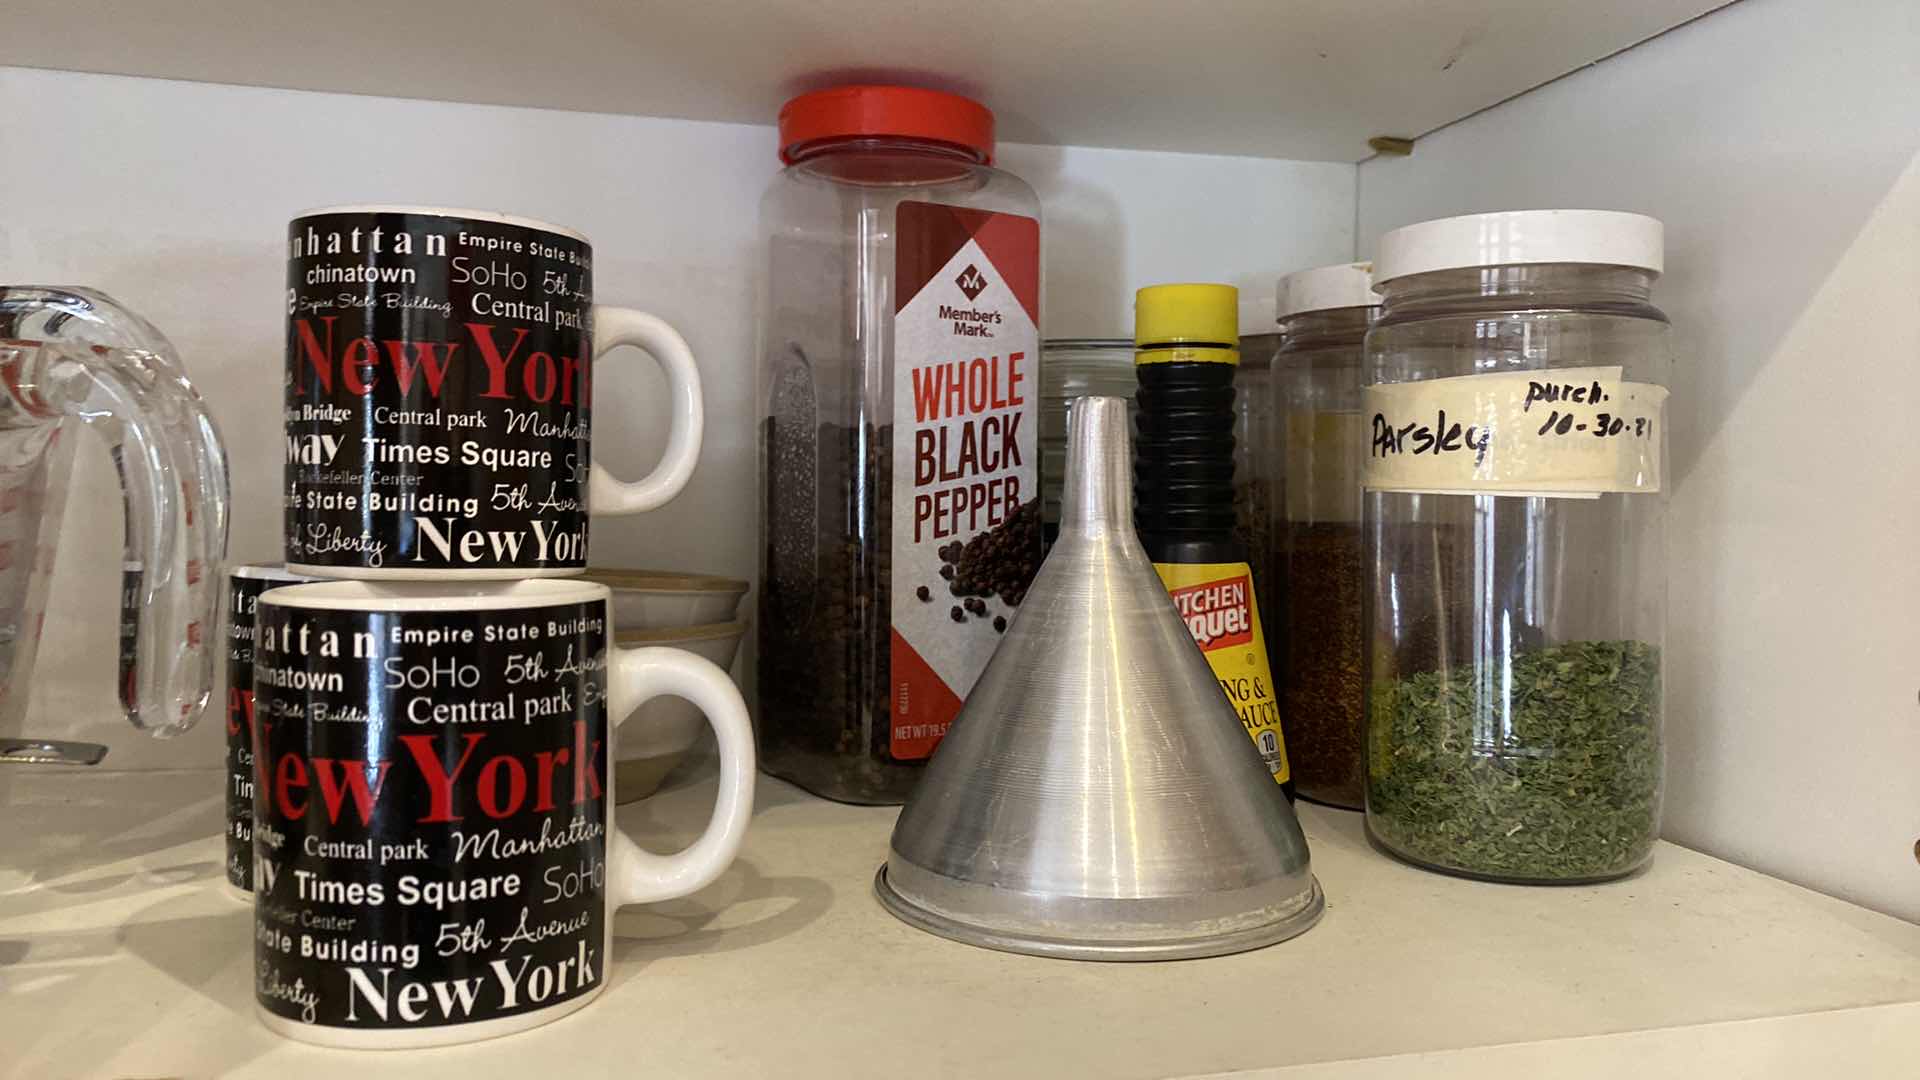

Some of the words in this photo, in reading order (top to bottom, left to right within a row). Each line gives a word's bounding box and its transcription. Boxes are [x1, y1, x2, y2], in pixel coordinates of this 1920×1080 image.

[459, 232, 523, 252] Empire
[530, 241, 566, 261] State
[306, 264, 416, 285] chinatown
[452, 257, 527, 290] SoHo
[381, 292, 455, 319] Building
[472, 292, 549, 323] Central
[555, 308, 583, 330] park
[939, 305, 1002, 325] Member's
[295, 316, 460, 399] New
[912, 352, 1025, 423] WHOLE
[1524, 381, 1609, 412] purch.
[303, 404, 352, 425] Bridge
[374, 407, 441, 427] Central
[447, 410, 488, 431] park
[362, 437, 450, 465] Times
[461, 440, 552, 472] Square
[915, 412, 1022, 487] BLACK
[371, 470, 424, 487] Center
[307, 491, 358, 510] State
[369, 493, 479, 518] Building
[491, 483, 533, 511] 5th
[914, 476, 1020, 544] PEPPER
[305, 522, 388, 568] Liberty
[412, 517, 527, 563] New
[392, 624, 474, 645] Empire
[485, 623, 540, 642] State
[548, 618, 602, 637] Building
[384, 656, 480, 689] SoHo
[504, 651, 549, 684] 5th
[1253, 677, 1267, 699] &
[407, 692, 515, 726] Central
[524, 687, 572, 725] park
[1262, 733, 1275, 752] 10
[398, 720, 602, 824] York
[304, 834, 373, 860] Central
[380, 839, 429, 865] park
[451, 818, 604, 863] Manhattan
[294, 869, 385, 907] Times
[397, 874, 521, 910] Square
[301, 909, 357, 931] Center
[435, 918, 492, 957] 5th
[500, 906, 590, 952] Avenue
[301, 934, 420, 969] Building
[345, 967, 485, 1023] New
[490, 940, 595, 1010] York
